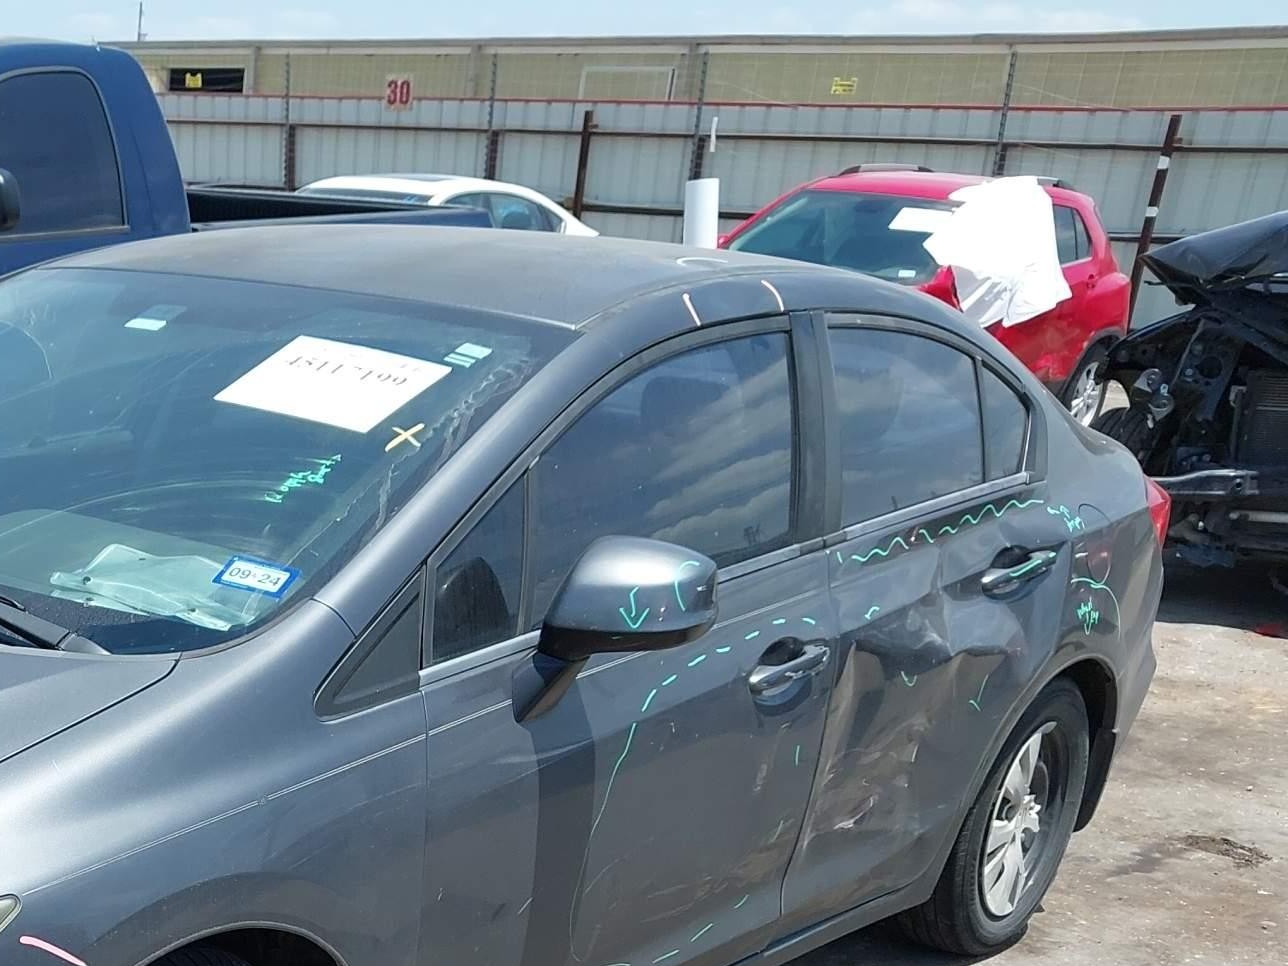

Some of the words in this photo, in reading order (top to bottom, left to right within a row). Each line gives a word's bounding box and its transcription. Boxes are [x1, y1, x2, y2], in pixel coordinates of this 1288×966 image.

[387, 79, 410, 105] 30
[285, 355, 408, 386] 4511199
[228, 567, 251, 579] 09
[257, 573, 282, 586] 24
